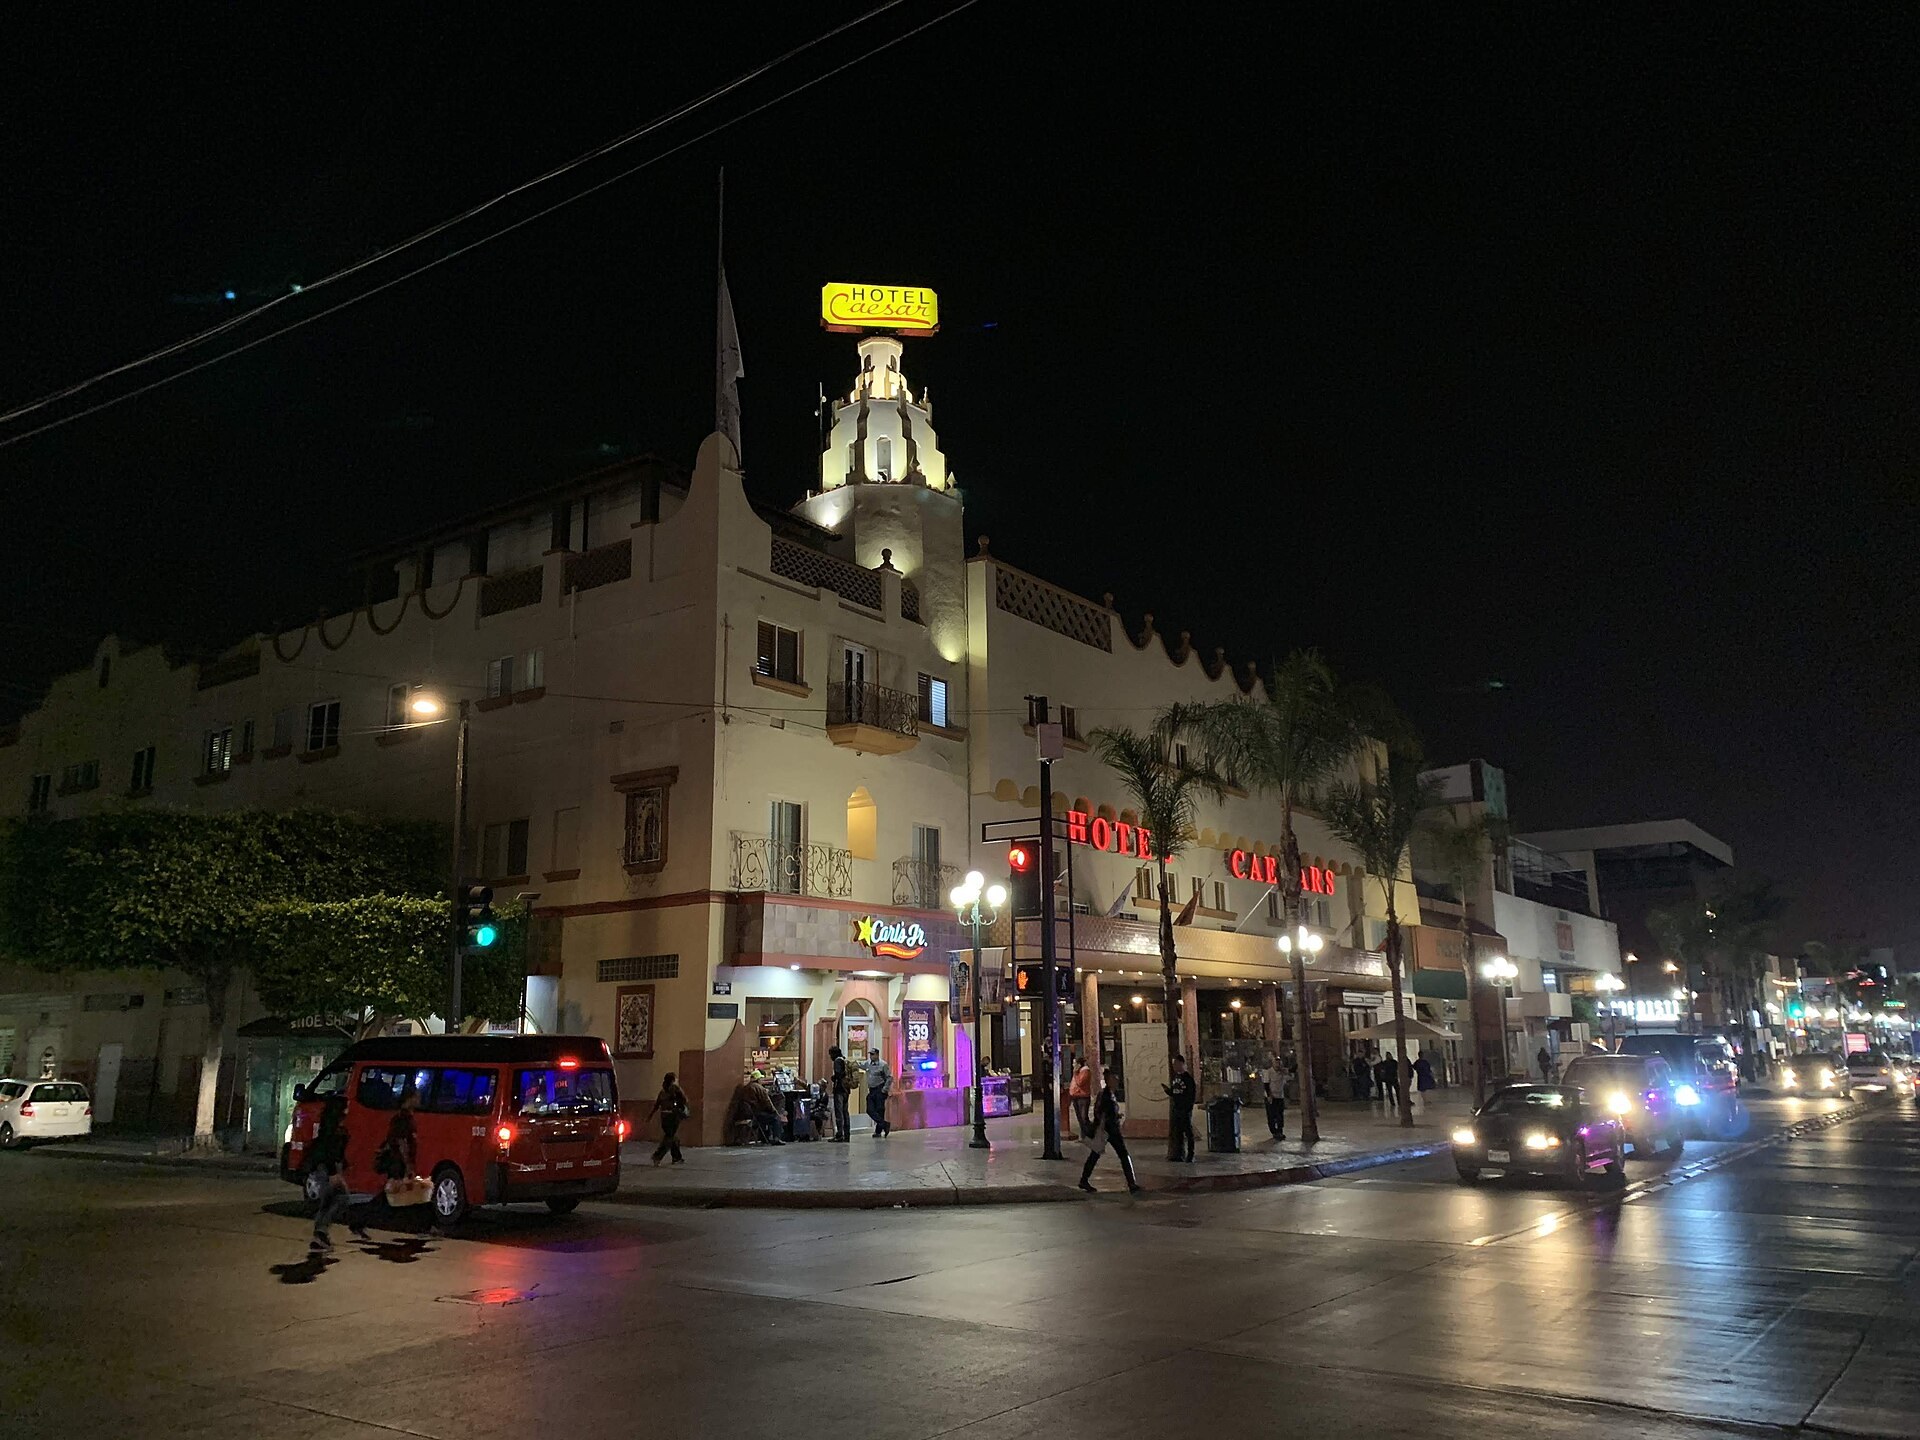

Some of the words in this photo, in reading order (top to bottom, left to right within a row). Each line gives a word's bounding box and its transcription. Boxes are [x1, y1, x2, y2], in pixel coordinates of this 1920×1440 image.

[830, 293, 931, 325] Caesar
[852, 288, 930, 304] HOTEL
[1067, 810, 1174, 864] HOTE
[1231, 849, 1335, 896] CAEARS
[870, 919, 908, 944] Carl's
[906, 923, 928, 947] Jr.
[908, 1024, 929, 1041] $39
